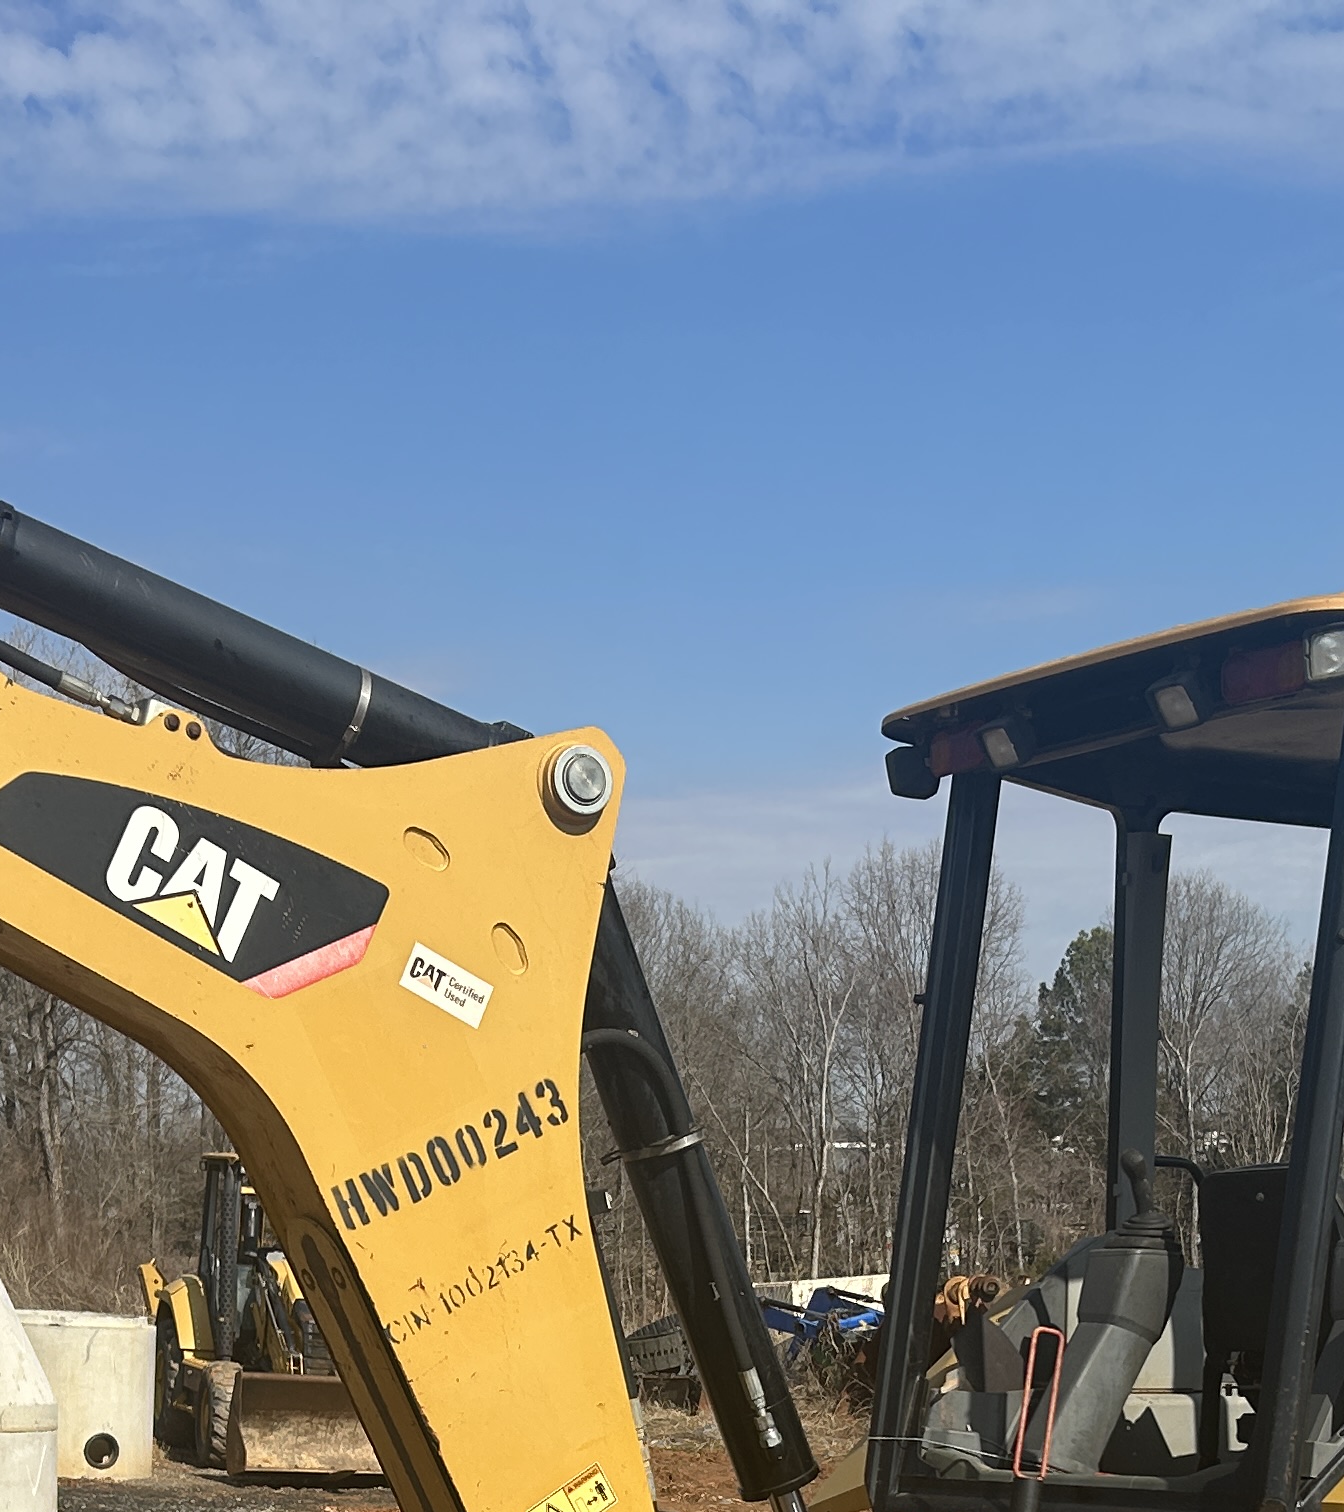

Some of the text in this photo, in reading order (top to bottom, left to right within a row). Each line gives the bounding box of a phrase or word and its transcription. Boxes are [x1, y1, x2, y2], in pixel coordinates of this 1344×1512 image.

[106, 805, 281, 963] CAT
[409, 957, 447, 992] CAT
[448, 977, 485, 1004] Certified
[444, 988, 467, 1008] Used
[330, 1077, 569, 1231] HWD00243
